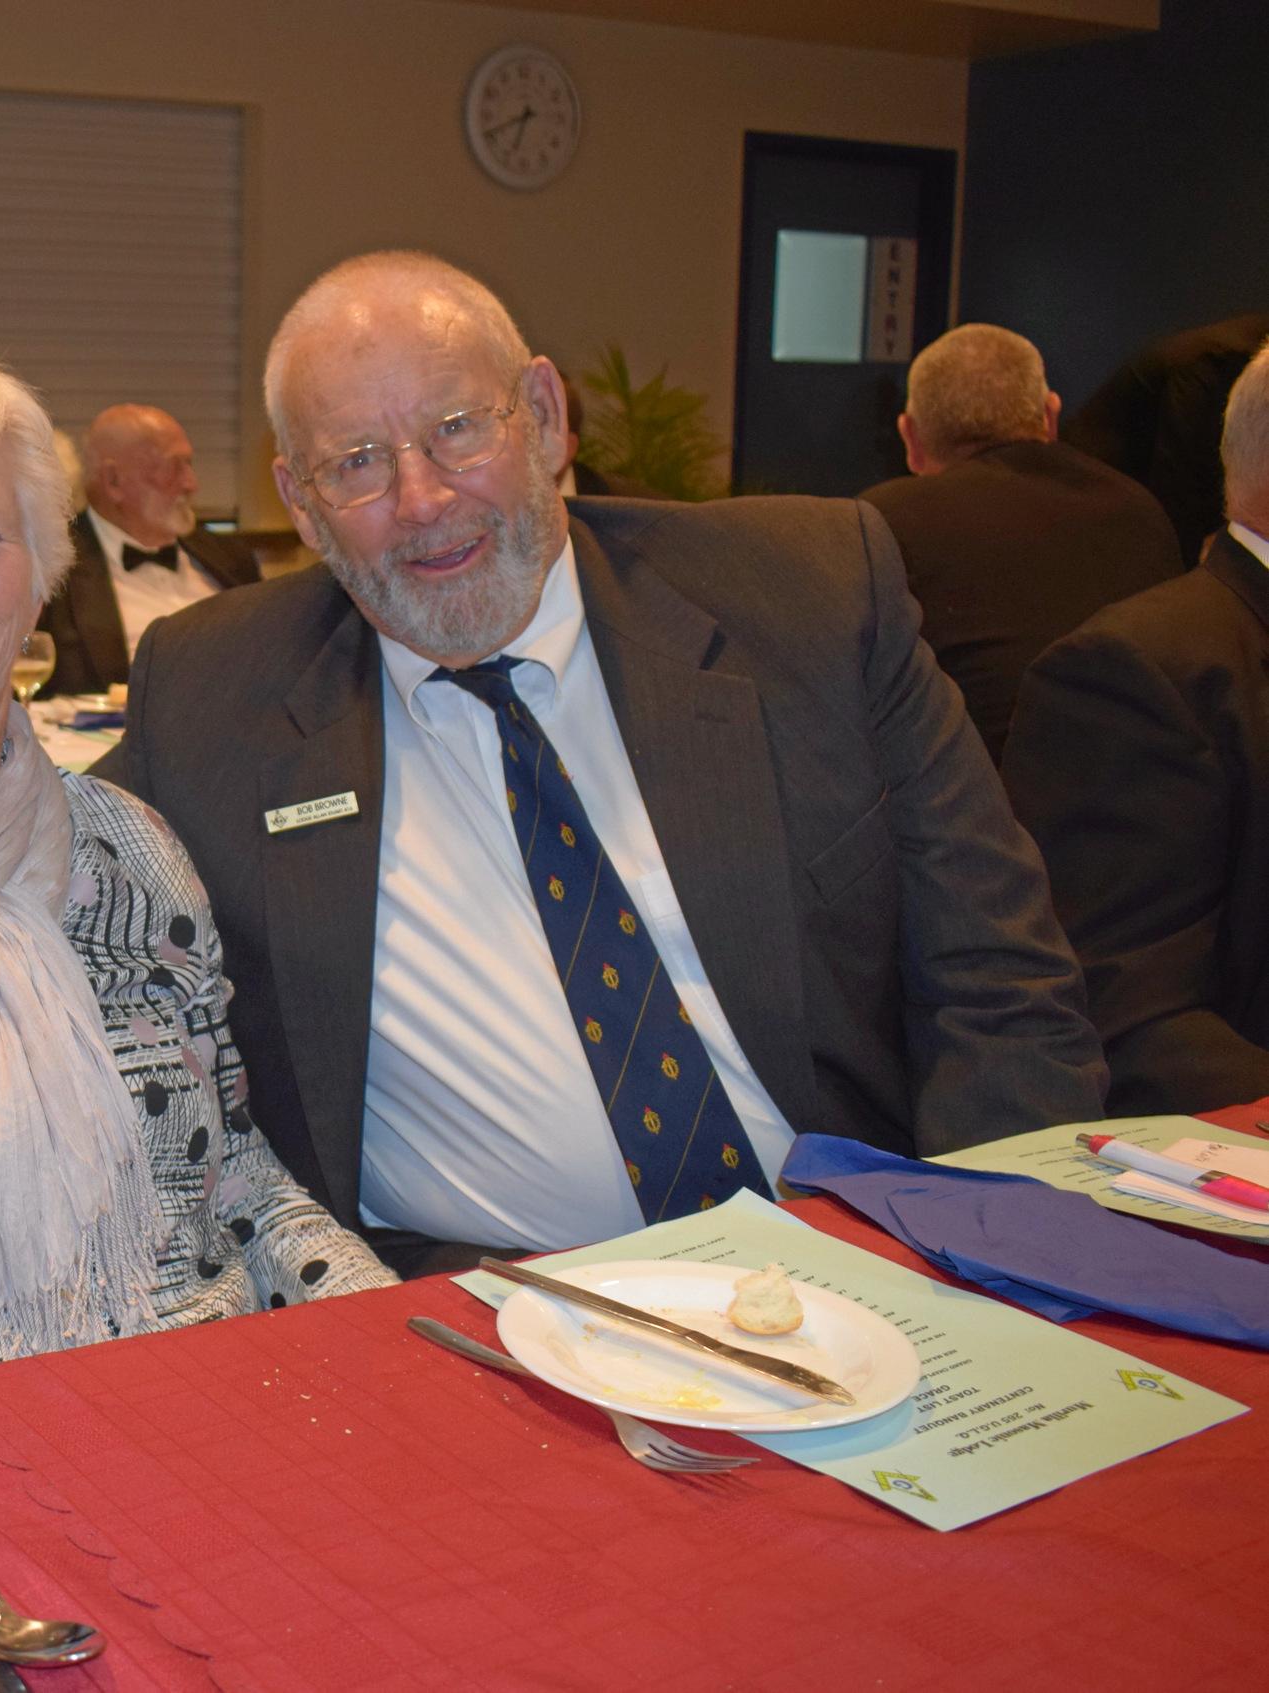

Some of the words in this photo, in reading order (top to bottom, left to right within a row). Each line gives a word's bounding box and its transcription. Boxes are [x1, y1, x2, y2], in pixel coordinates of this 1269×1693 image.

[296, 805, 313, 816] BOB
[314, 796, 347, 812] BROWNE
[906, 1384, 951, 1403] GRACE
[942, 1386, 981, 1405] TOAST
[968, 1385, 1034, 1415] CENTENARY
[916, 1400, 943, 1414] LIST
[1040, 1400, 1094, 1422] Murilla
[913, 1411, 969, 1435] BANQUET
[1000, 1411, 1024, 1424] 265
[988, 1420, 1047, 1443] Masonic
[947, 1439, 994, 1457] Lodge
